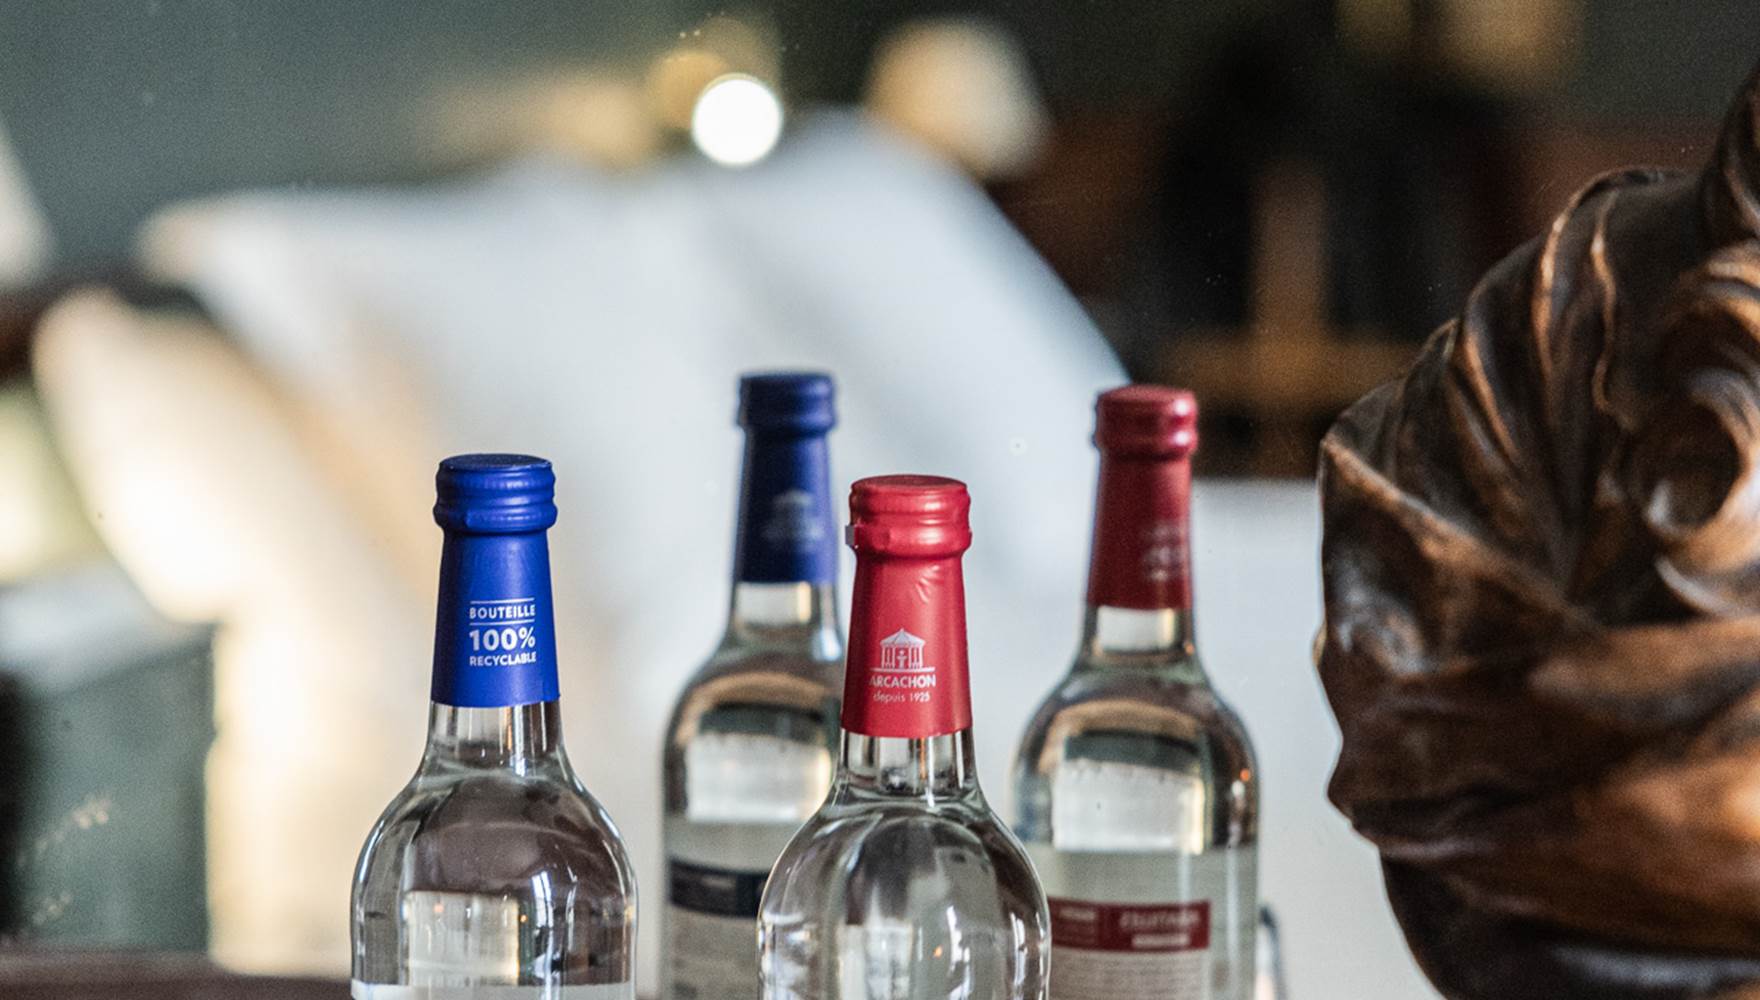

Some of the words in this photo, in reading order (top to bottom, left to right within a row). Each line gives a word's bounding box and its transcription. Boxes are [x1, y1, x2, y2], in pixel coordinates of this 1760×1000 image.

[469, 604, 536, 619] BOUTEILLE
[469, 626, 536, 651] 100%
[469, 651, 537, 667] RECYCLABLE
[868, 674, 937, 688] ARCACHON
[873, 690, 906, 704] depuis
